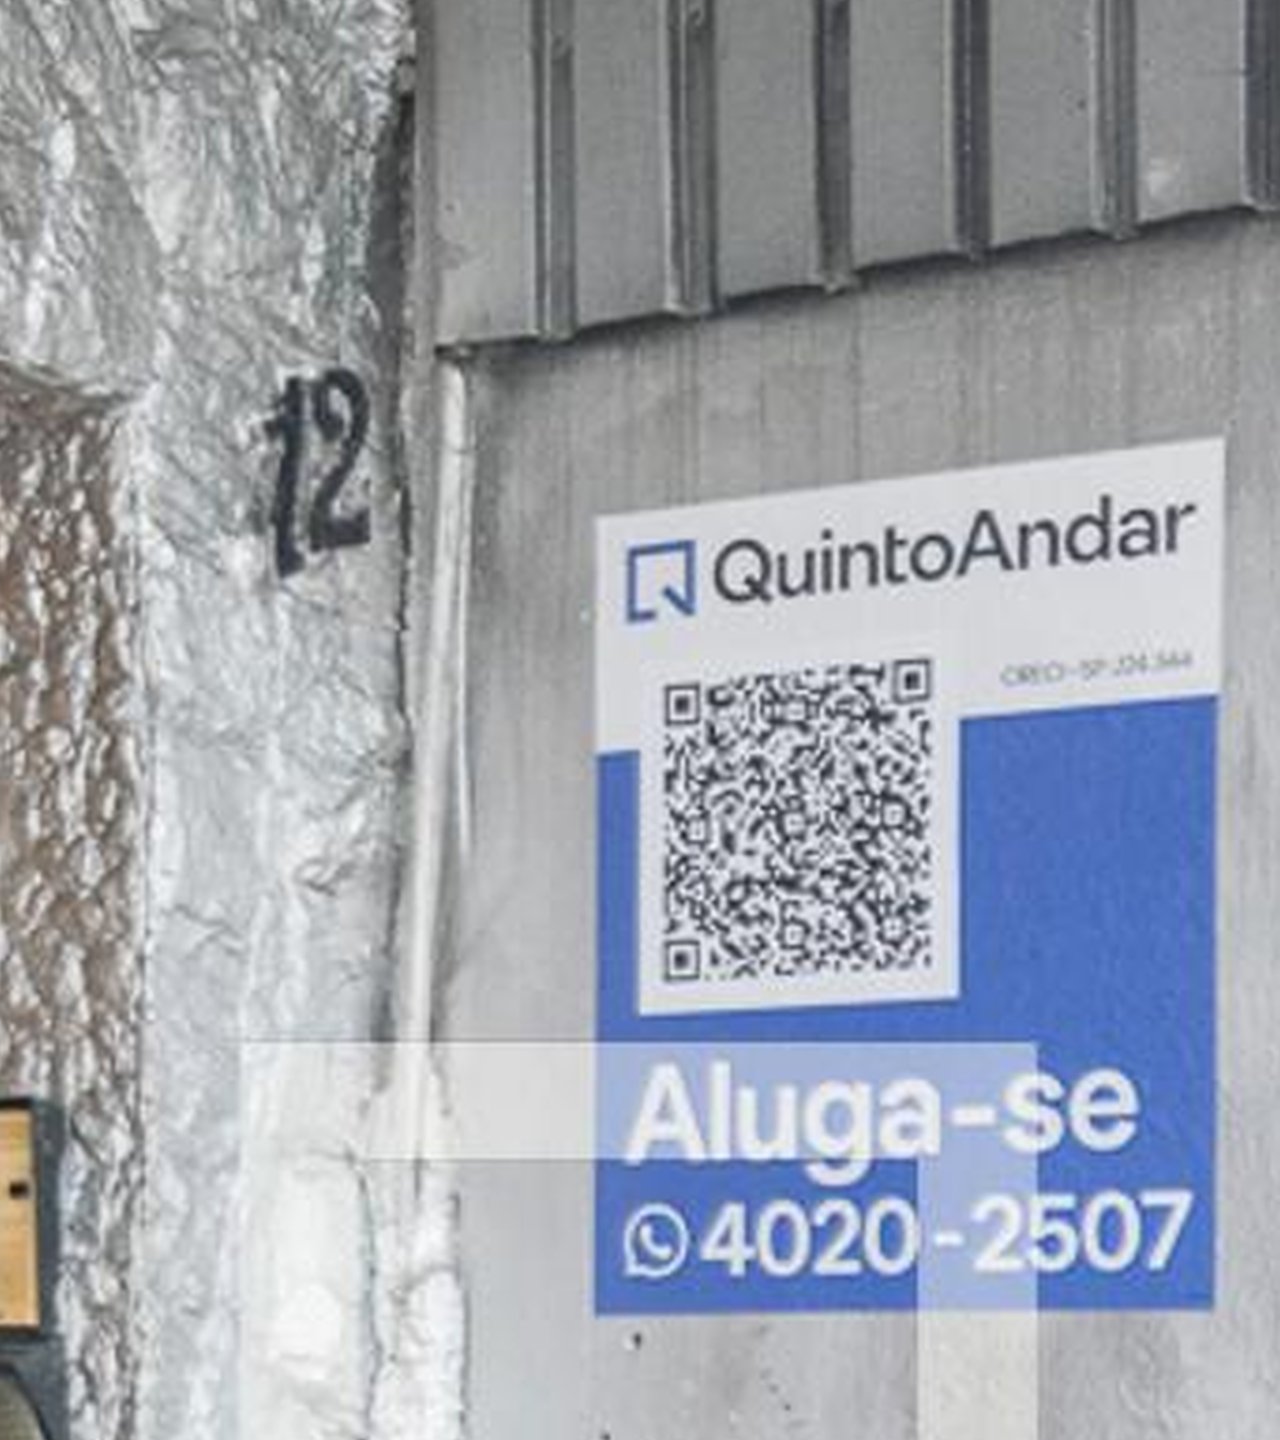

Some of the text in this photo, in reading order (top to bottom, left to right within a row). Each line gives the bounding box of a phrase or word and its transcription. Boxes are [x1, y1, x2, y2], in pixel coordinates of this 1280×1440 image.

[263, 369, 371, 578] 12
[713, 495, 1197, 604] QuintoAndar
[622, 1060, 1140, 1187] Aluga-se
[700, 1188, 1194, 1276] 4020-2507
